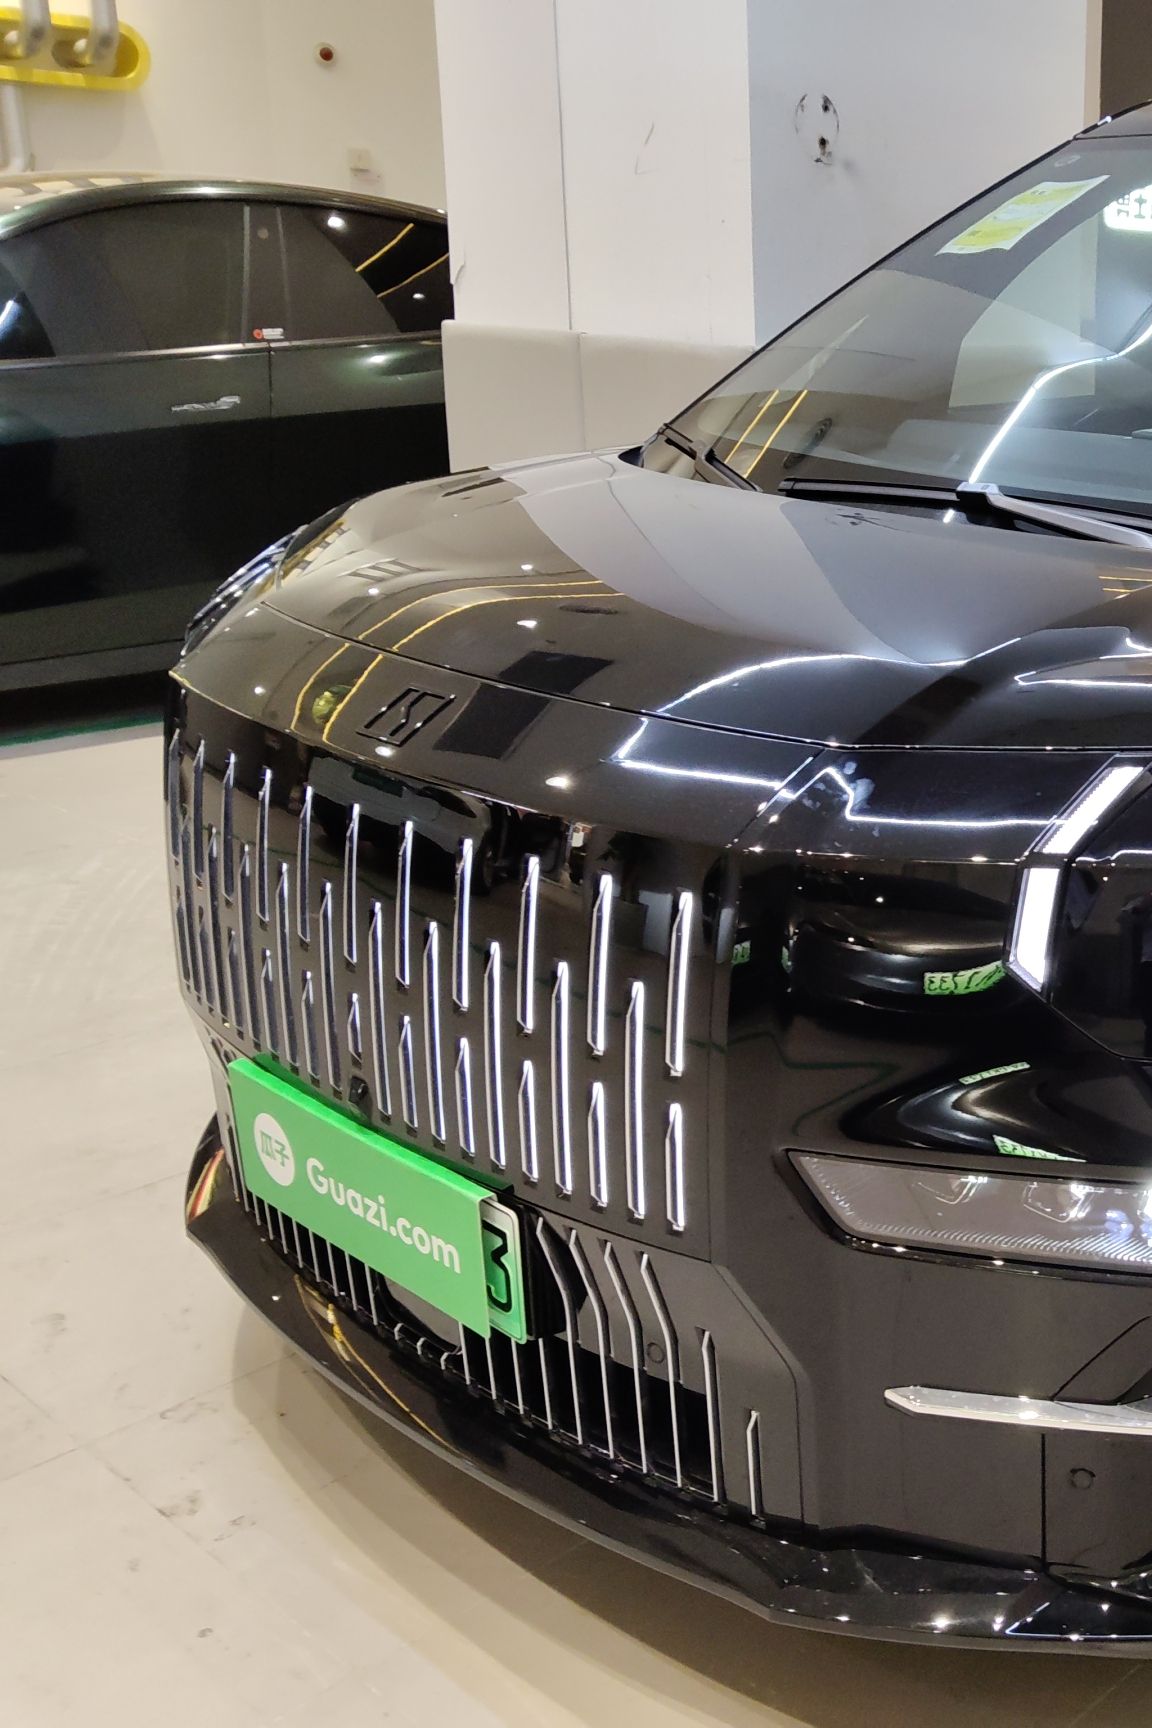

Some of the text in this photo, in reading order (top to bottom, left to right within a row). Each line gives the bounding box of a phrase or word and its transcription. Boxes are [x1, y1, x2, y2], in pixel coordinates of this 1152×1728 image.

[260, 1130, 290, 1167] 瓜子
[306, 1158, 461, 1274] Guazi.com
[482, 1219, 512, 1313] 3
